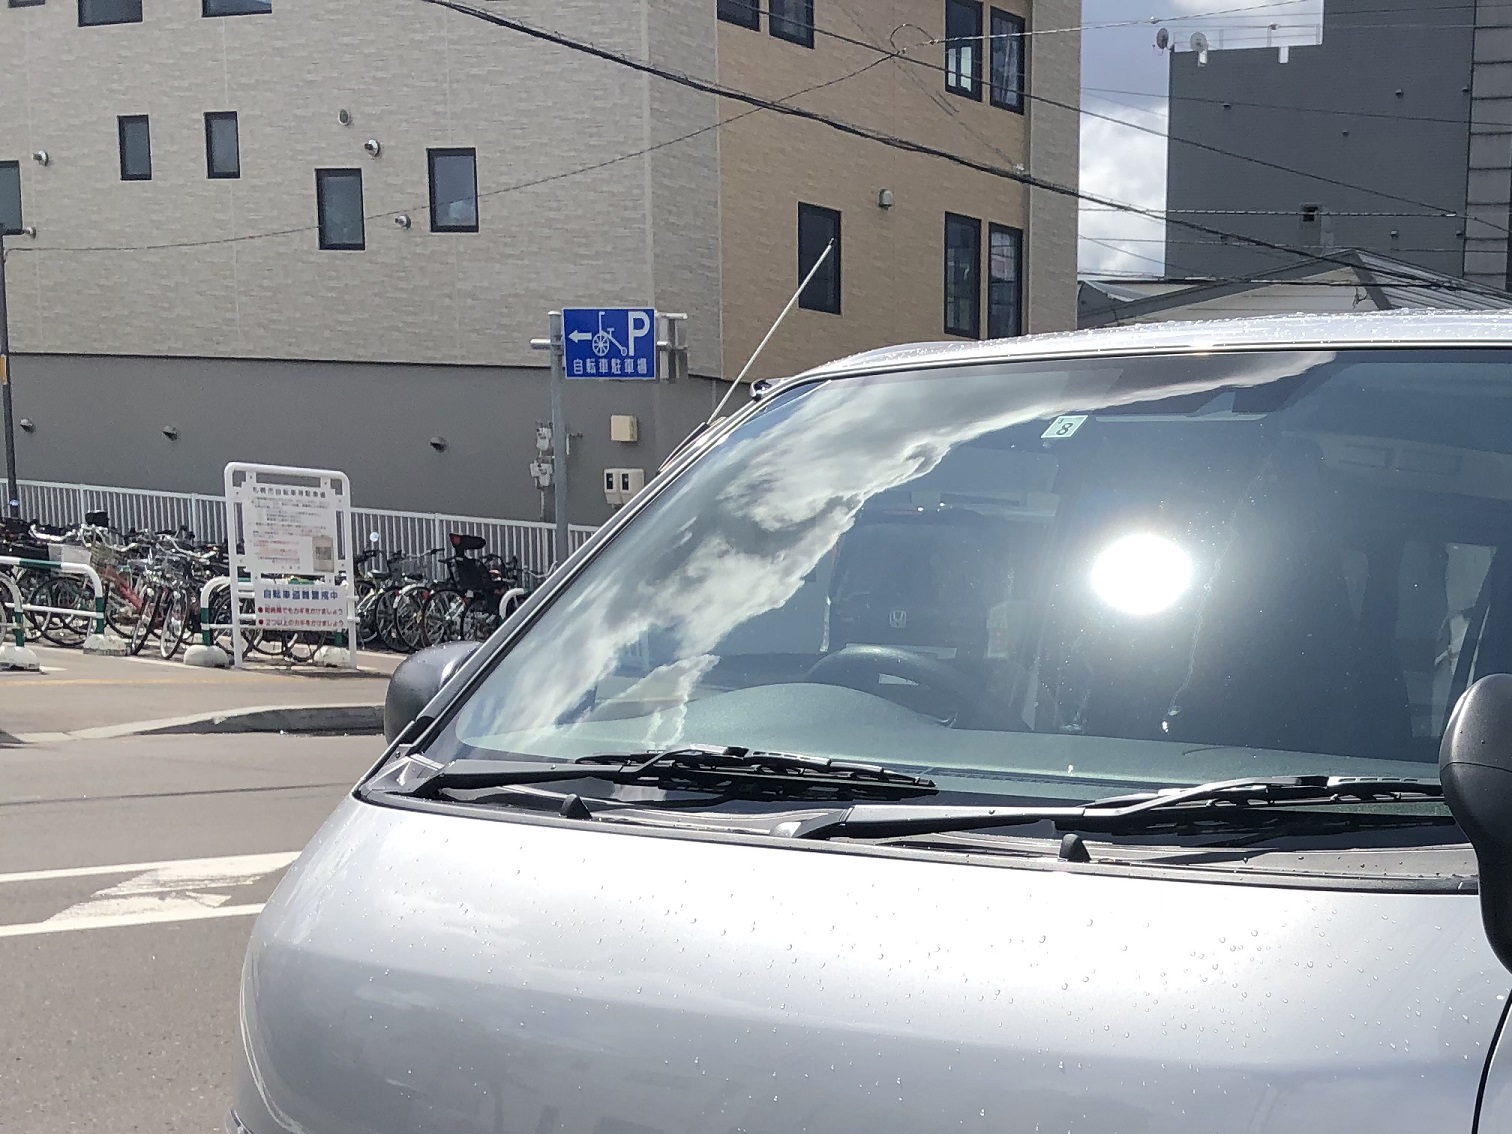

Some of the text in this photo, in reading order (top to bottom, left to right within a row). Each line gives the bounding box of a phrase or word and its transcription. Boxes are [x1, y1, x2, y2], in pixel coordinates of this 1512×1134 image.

[627, 311, 650, 356] P
[573, 358, 647, 374] 自転車駐車場
[1056, 423, 1073, 435] 8
[263, 589, 338, 600] 自転車盗難警戒中
